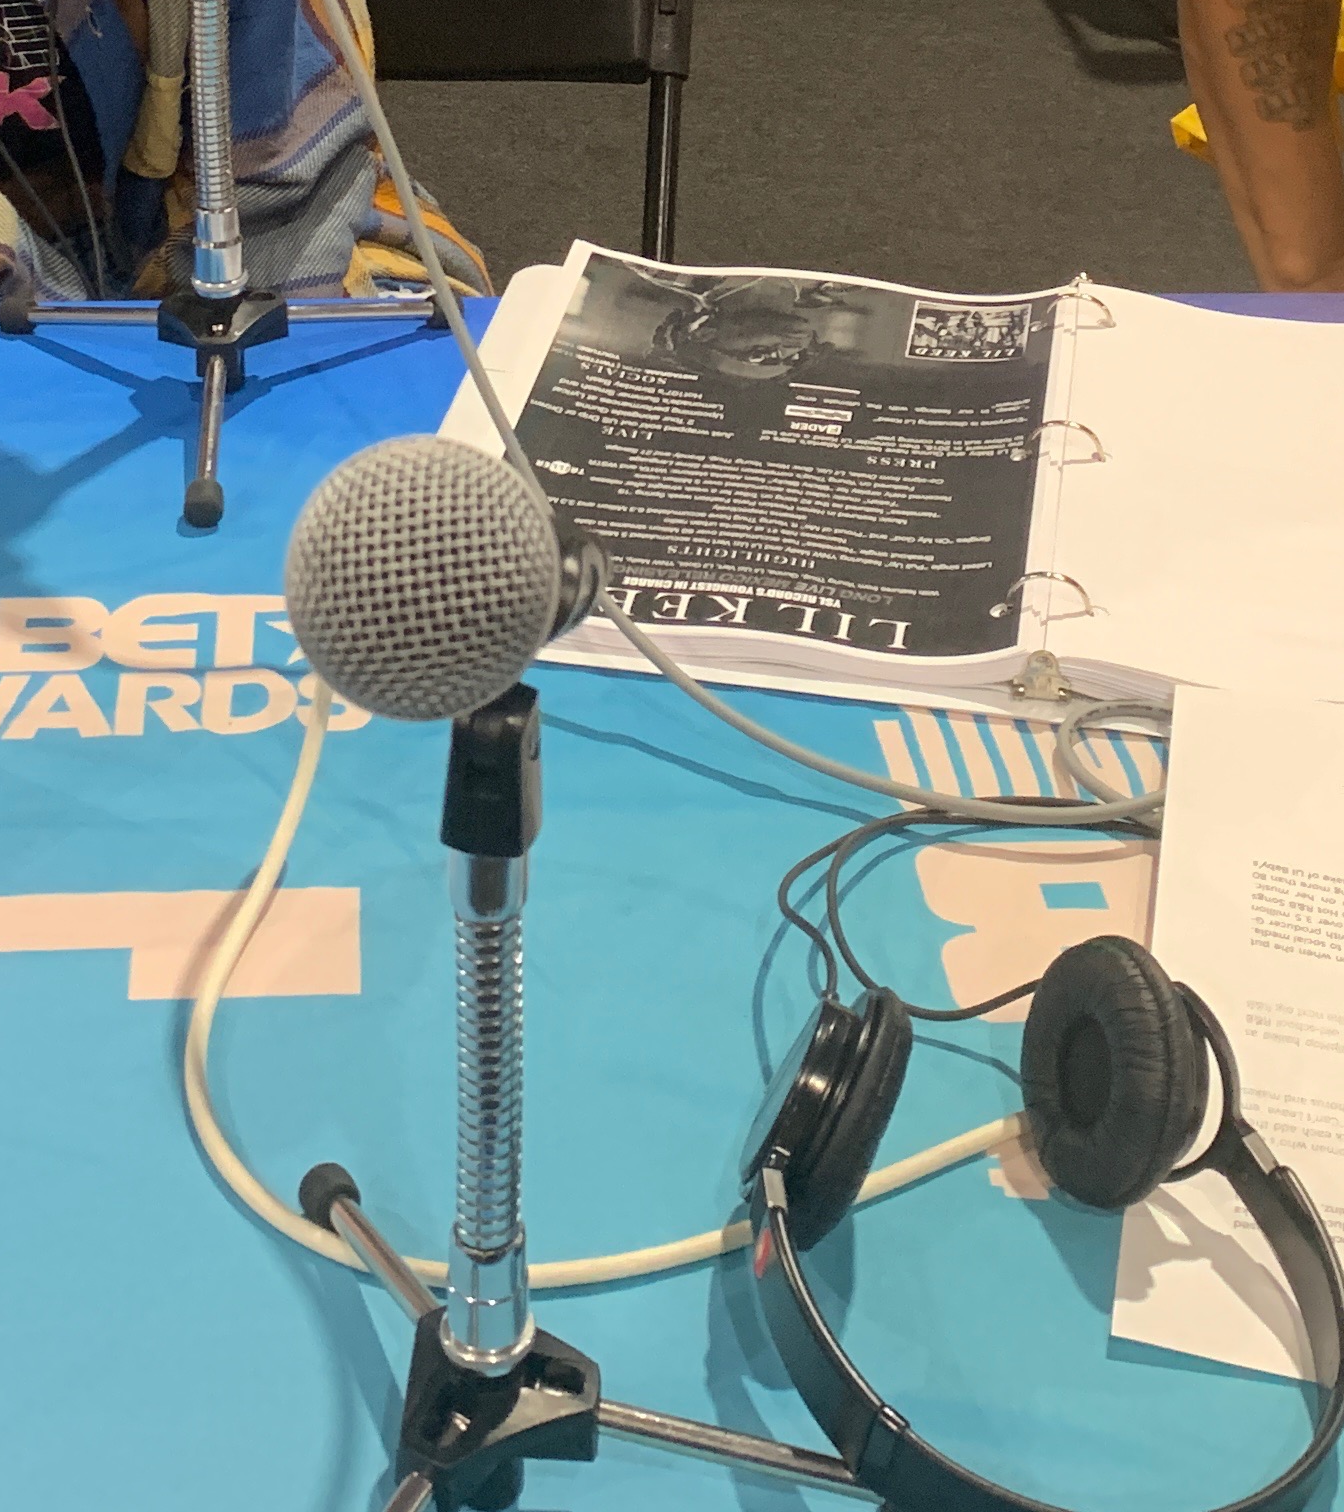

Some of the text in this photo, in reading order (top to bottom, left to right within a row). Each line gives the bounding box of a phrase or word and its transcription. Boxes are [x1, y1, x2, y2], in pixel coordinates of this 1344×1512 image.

[914, 346, 1017, 359] LIL KEED
[580, 362, 668, 386] SOCIALS
[600, 426, 654, 441] LIVE
[866, 456, 937, 471] PRESS
[666, 544, 816, 570] HIGHLIGHTS
[611, 564, 894, 605] LONG LIVE MEXICO RELEASING
[622, 576, 673, 589] CHARGE
[674, 581, 688, 591] IN
[689, 580, 754, 596] YOUNGEST
[756, 587, 810, 604] RECORD'S
[599, 587, 912, 650] LIL KEE
